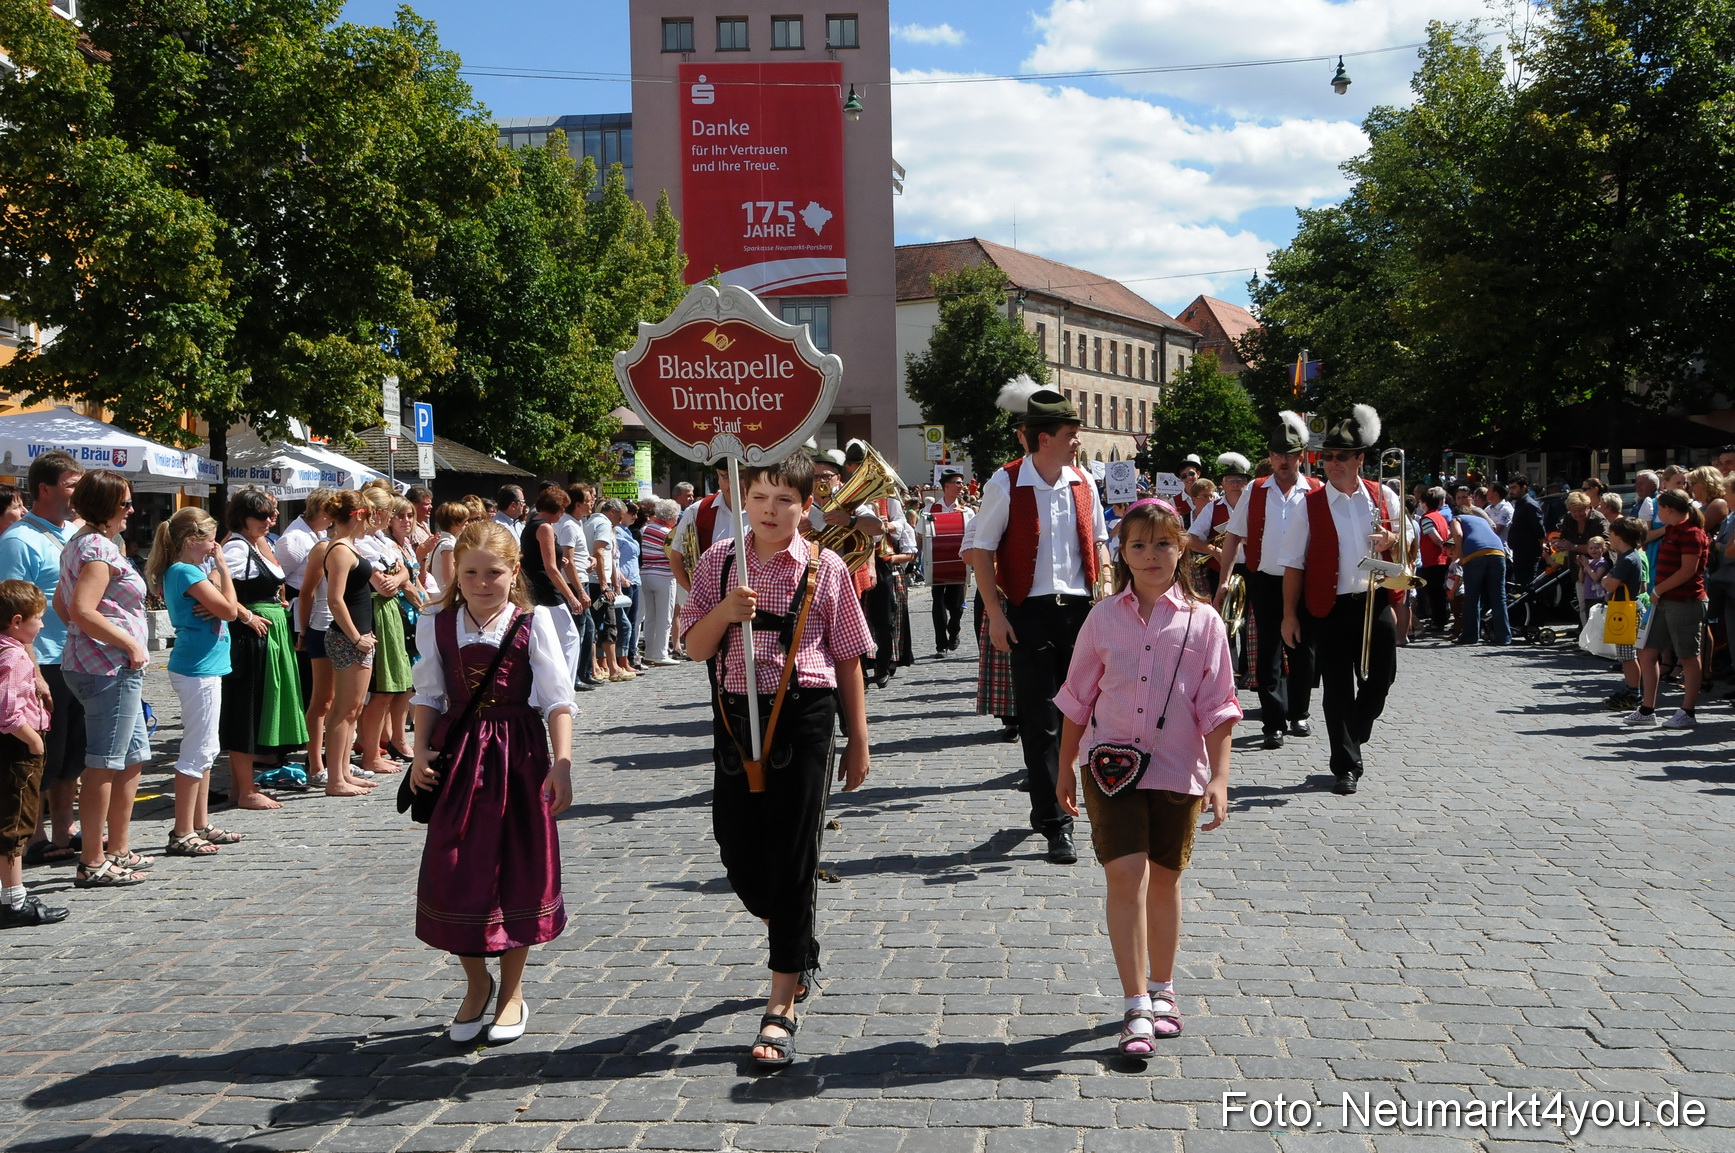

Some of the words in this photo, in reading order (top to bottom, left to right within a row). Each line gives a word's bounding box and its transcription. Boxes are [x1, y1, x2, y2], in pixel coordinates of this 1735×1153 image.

[692, 118, 750, 136] Danke
[692, 144, 708, 156] für
[711, 144, 728, 156] Ihr
[730, 144, 788, 155] Vertrauen
[692, 160, 715, 172] und
[718, 160, 741, 171] Ihre
[743, 160, 780, 171] Treue.
[741, 201, 796, 224] 175
[743, 224, 796, 238] JAHRE
[743, 245, 774, 253] Sparkasse
[775, 244, 833, 252] Neumarkt-Parsberg
[658, 353, 795, 386] Blaskapelle
[670, 386, 785, 411] Dirnhofer
[418, 407, 429, 438] P
[712, 416, 742, 434] Stauf
[81, 446, 110, 461] Bräu
[250, 467, 270, 480] Bräu
[321, 470, 336, 482] Bräu
